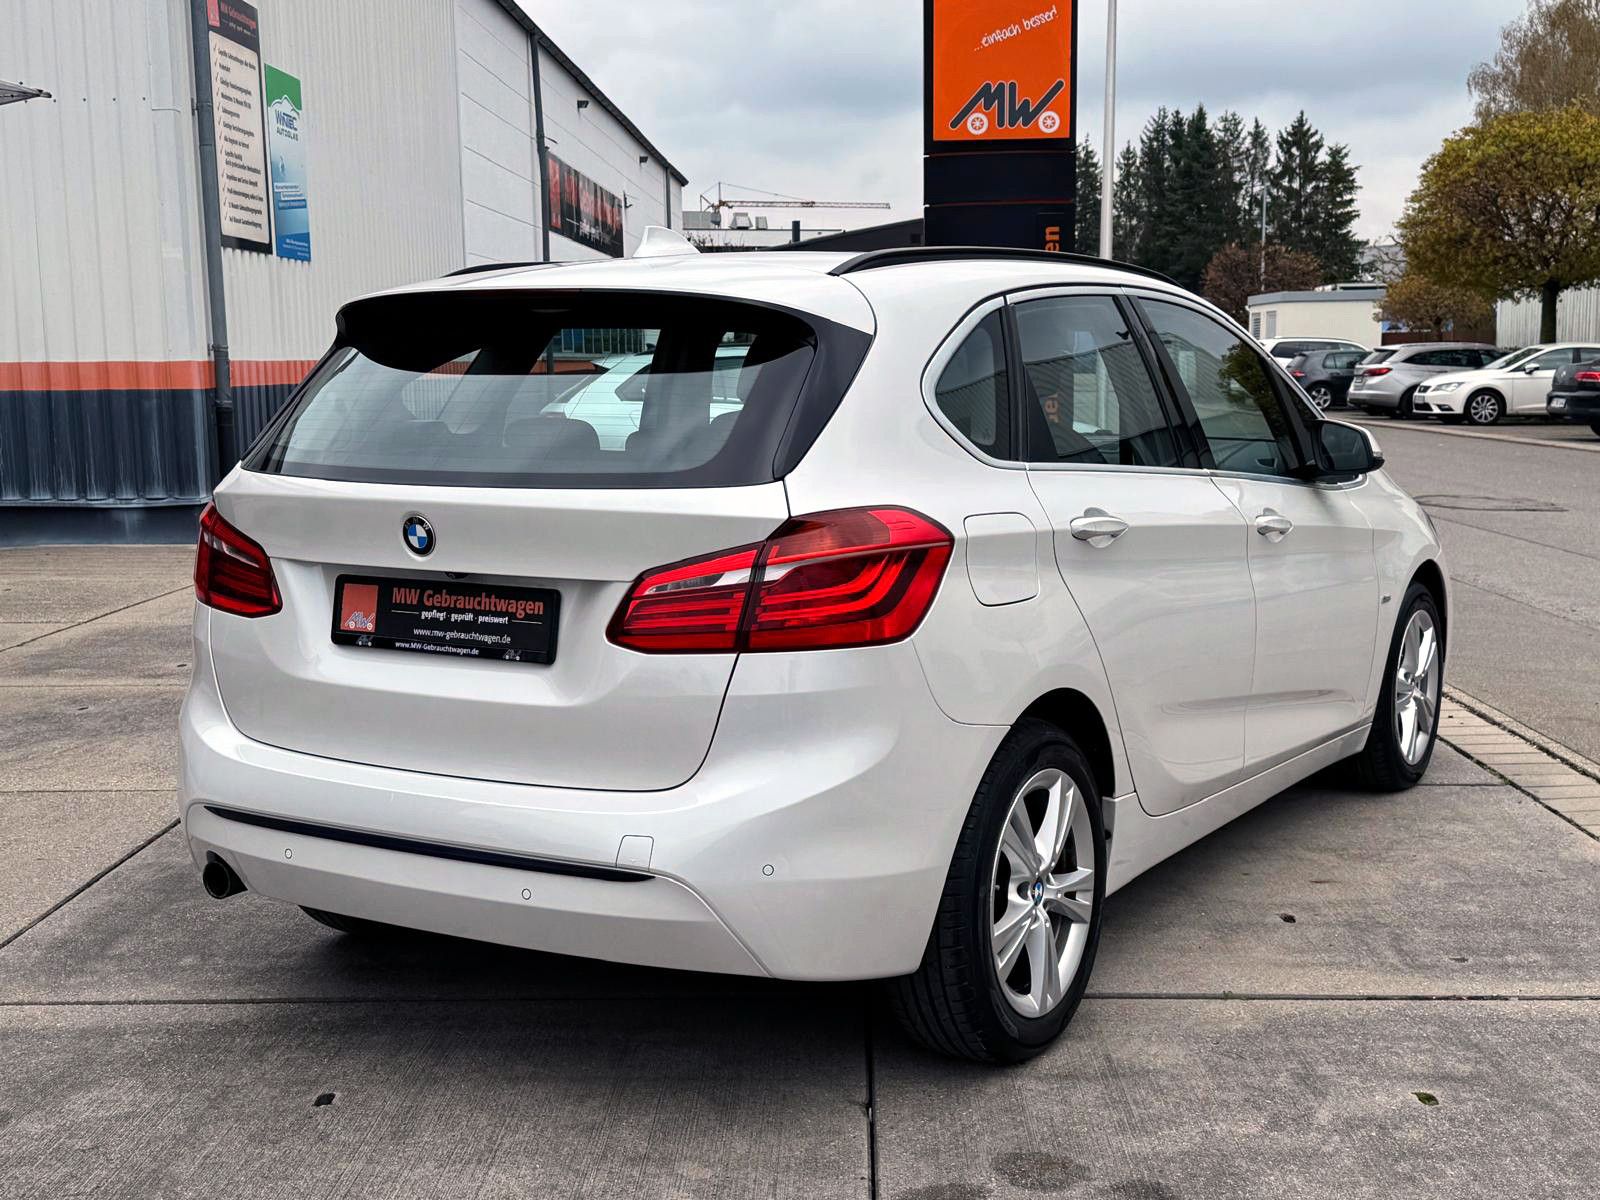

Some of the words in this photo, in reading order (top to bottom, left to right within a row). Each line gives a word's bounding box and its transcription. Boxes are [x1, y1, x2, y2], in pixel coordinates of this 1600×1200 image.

[1022, 4, 1059, 31] besser!
[950, 80, 1065, 130] MW
[392, 587, 420, 605] MW
[423, 589, 544, 619] Gebrauchtwagen
[421, 609, 447, 621] gepflegt
[451, 612, 474, 622] geprüft
[478, 614, 509, 625] preiswert
[413, 628, 511, 645] www.mw-gebrauchtwagen.de
[395, 641, 480, 656] www.MW-Gebrauchtwagen.de
